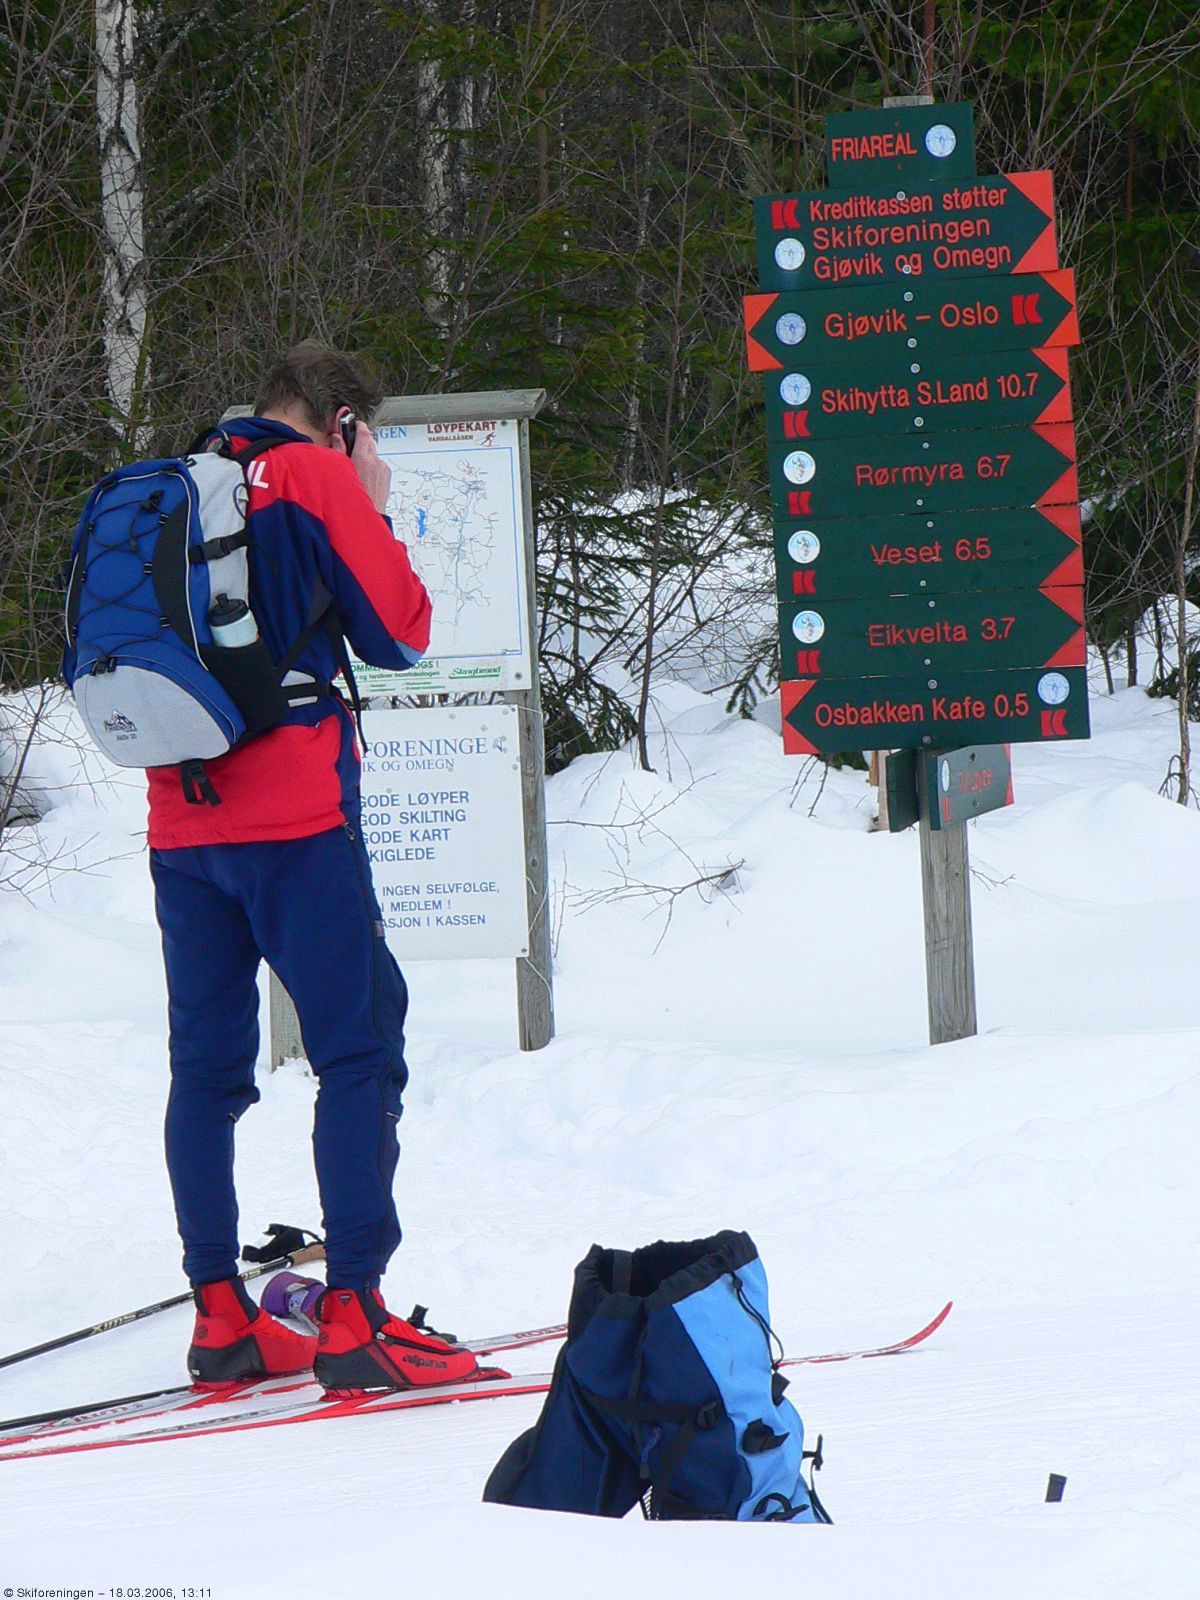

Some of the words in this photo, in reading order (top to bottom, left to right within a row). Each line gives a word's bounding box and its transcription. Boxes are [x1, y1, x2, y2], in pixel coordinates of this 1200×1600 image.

[831, 133, 917, 161] FRIAREAL
[809, 193, 933, 222] Kreditkassen
[942, 187, 1007, 210] støtter
[812, 217, 991, 250] Skiforeningen
[813, 253, 884, 282] Gjøvik
[895, 253, 922, 275] og
[933, 245, 1011, 271] Omegn
[824, 309, 908, 340] Gjøvik
[939, 302, 999, 328] Oslo
[821, 386, 910, 415] Skihytta
[917, 378, 989, 406] S.Land
[996, 372, 1039, 398] 10.7
[374, 427, 407, 440] GEN
[427, 421, 497, 434] LØYPEKART
[855, 463, 964, 487] Rørmyra
[976, 455, 1012, 478] 6.7
[870, 541, 942, 566] Veset
[955, 537, 992, 561] 6.5
[867, 620, 968, 647] Eikvelta
[980, 617, 1015, 641] 3.7
[815, 698, 924, 728] Osbakken
[932, 695, 986, 721] Kafe
[993, 693, 1030, 718] 0.5
[363, 761, 376, 773] IK
[382, 760, 400, 772] OG
[406, 758, 454, 771] OMEGN
[408, 791, 469, 806] LØYPER
[400, 809, 466, 825] SKILTING
[410, 828, 450, 843] KART
[369, 847, 435, 862] KIGLEDE
[382, 885, 420, 896] INGEN
[426, 881, 499, 895] SELVFØLGE,
[391, 899, 441, 912] MEDLEM
[382, 917, 421, 928] ASJON
[436, 914, 486, 926] KASSEN
